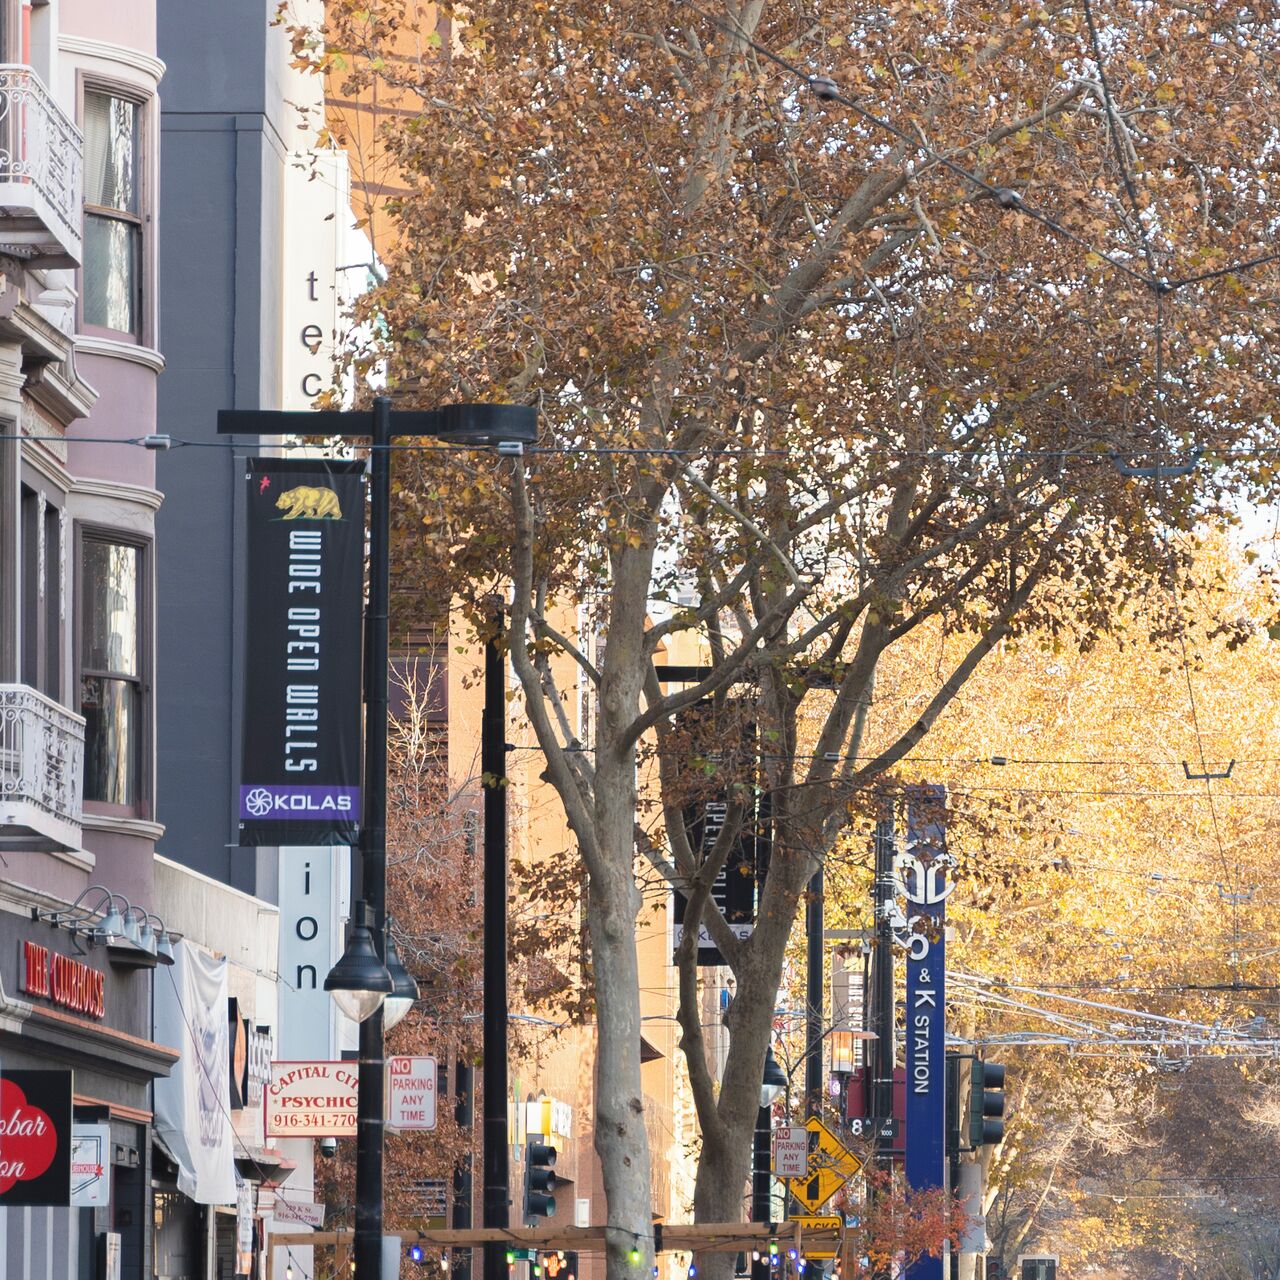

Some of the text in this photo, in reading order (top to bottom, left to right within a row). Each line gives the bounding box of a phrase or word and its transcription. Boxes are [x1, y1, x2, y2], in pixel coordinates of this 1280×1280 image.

[284, 530, 322, 772] WIDE OPEN WALLS
[275, 795, 352, 811] KOLAS
[24, 940, 106, 1019] THE CLUBHOUSE
[918, 968, 931, 983] &
[915, 989, 936, 1008] K
[914, 1015, 930, 1094] STATION
[393, 1060, 411, 1073] NO
[269, 1066, 331, 1096] CAPITAL
[335, 1070, 359, 1089] CIT
[393, 1078, 433, 1091] PARKING
[401, 1095, 425, 1106] ANY
[274, 1113, 359, 1127] 916-341-770
[400, 1110, 426, 1121] TIME
[777, 1129, 790, 1139] NO
[777, 1141, 806, 1150] PARKING
[783, 1153, 800, 1161] ANY
[782, 1164, 801, 1172] TIME
